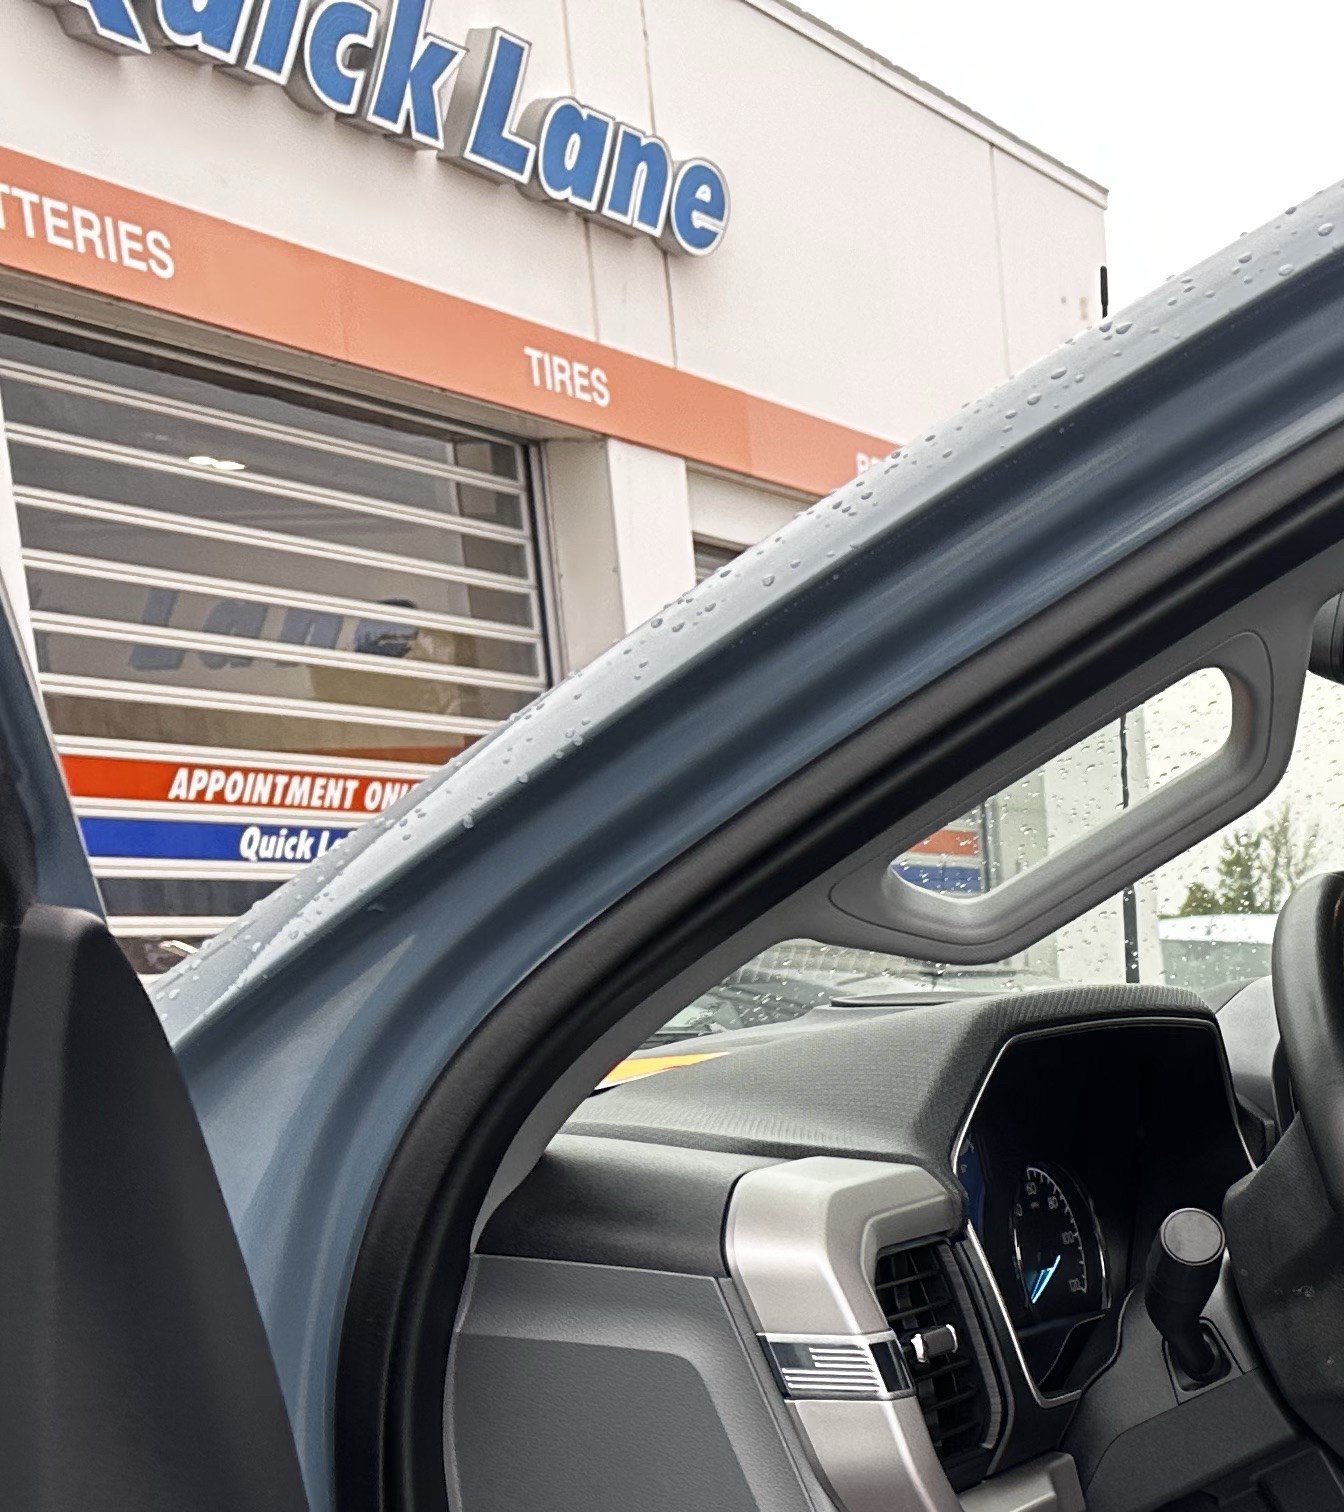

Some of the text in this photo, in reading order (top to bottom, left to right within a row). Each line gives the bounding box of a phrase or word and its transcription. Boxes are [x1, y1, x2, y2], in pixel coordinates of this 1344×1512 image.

[68, 0, 731, 257] ick Lane
[523, 346, 611, 408] TIRES
[168, 767, 420, 810] APPOINTMENT ON
[239, 826, 315, 861] Quick
